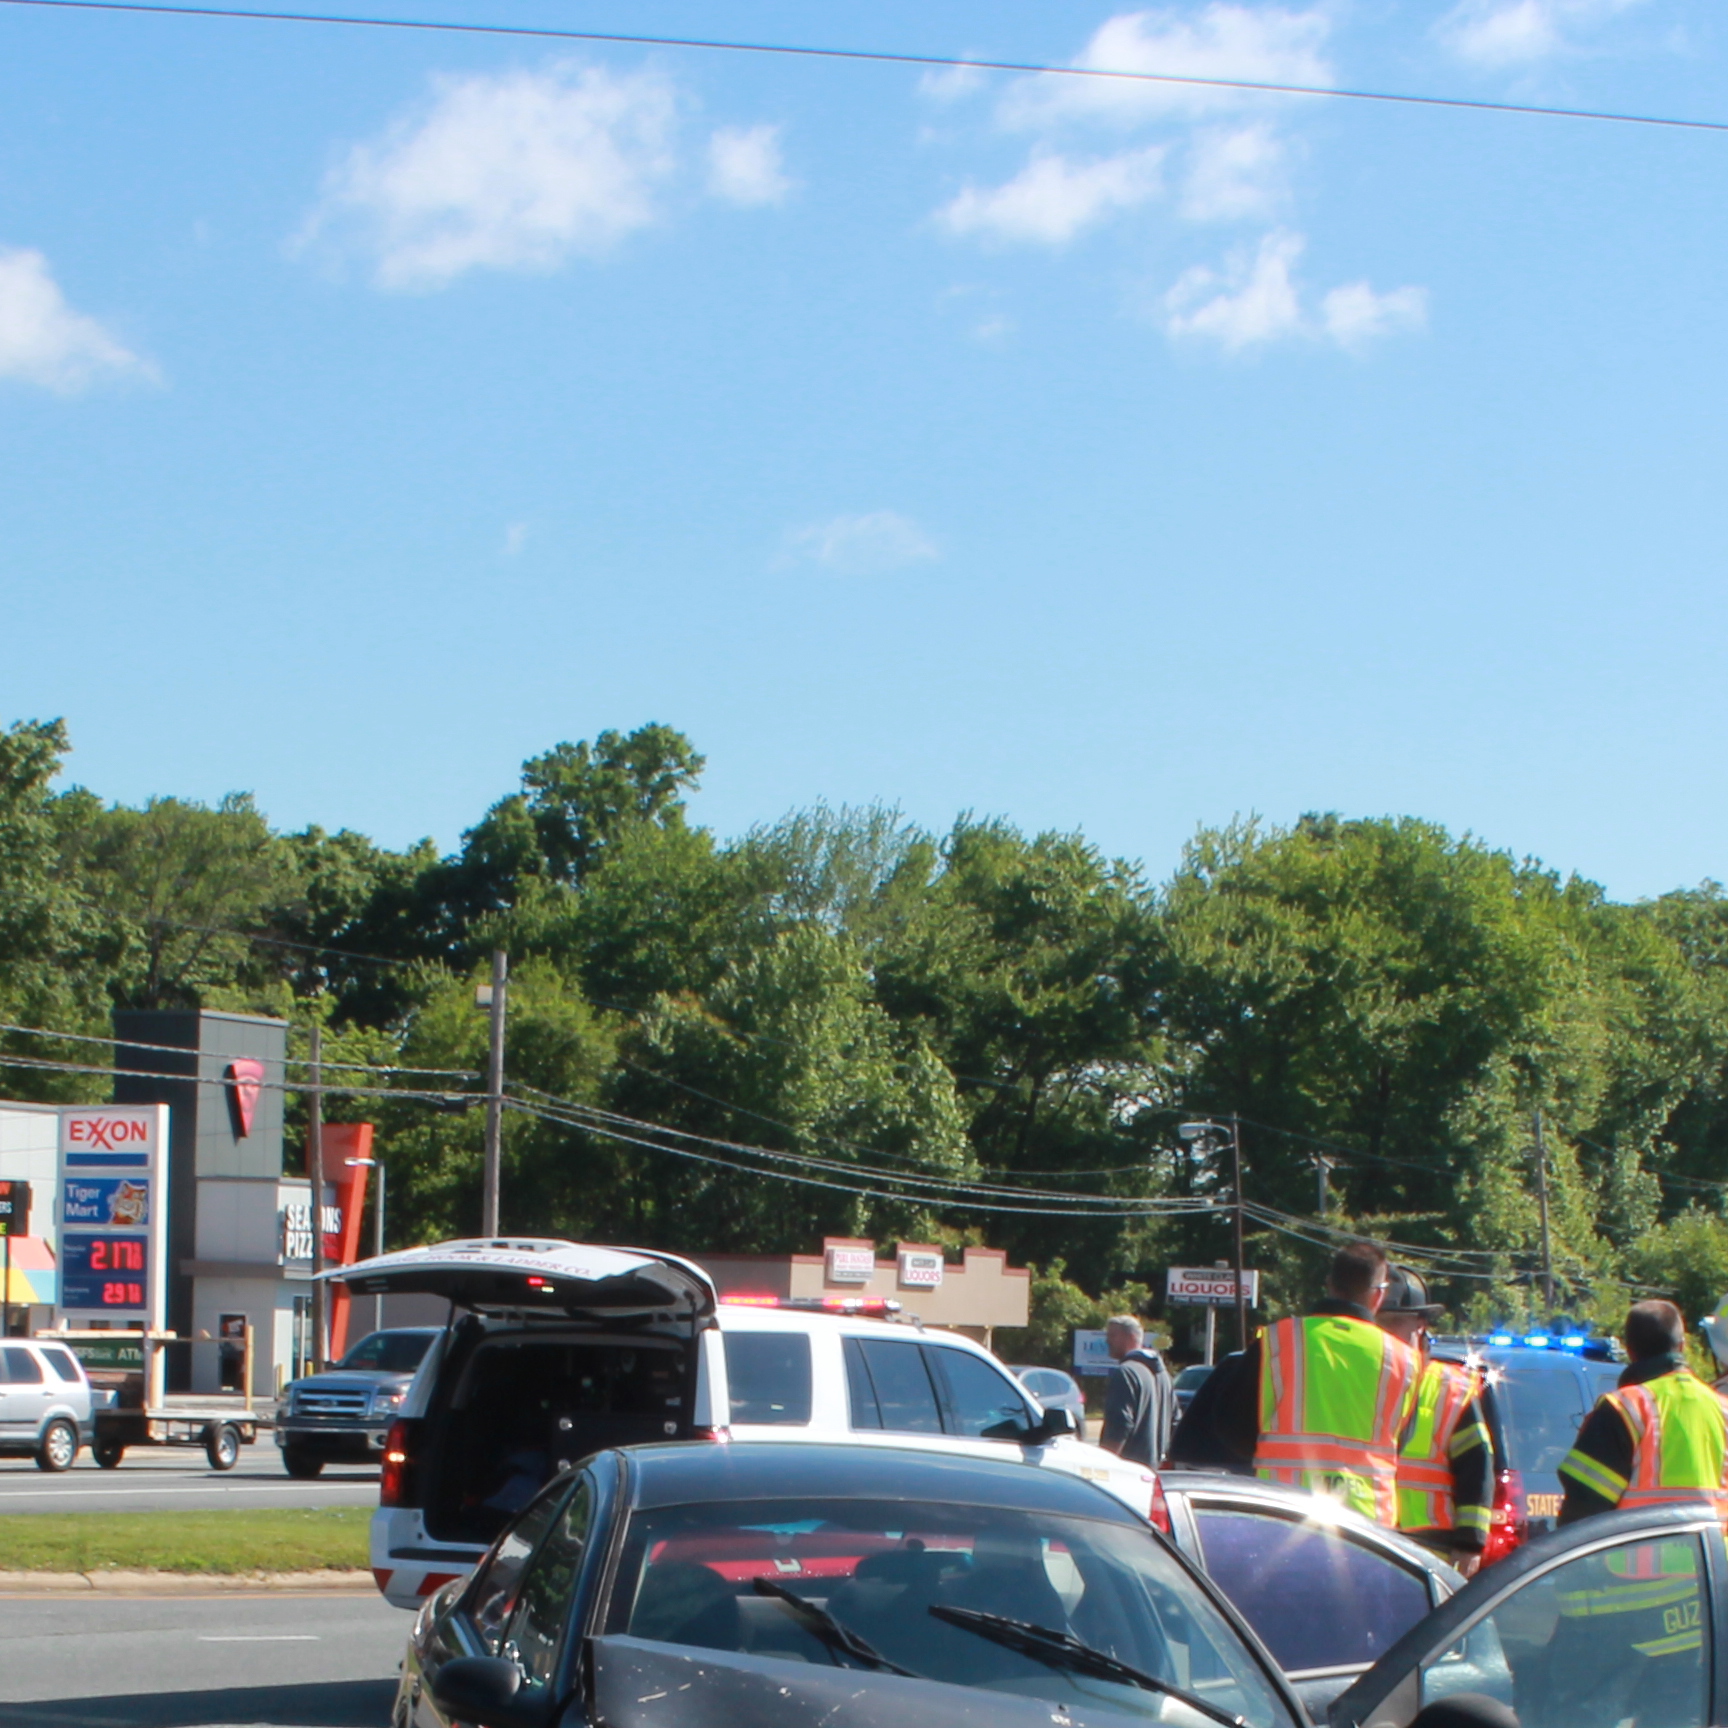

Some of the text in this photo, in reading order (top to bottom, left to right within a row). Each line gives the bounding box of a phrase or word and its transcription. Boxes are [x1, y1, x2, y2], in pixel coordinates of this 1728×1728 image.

[69, 1117, 147, 1150] EXXON
[65, 1184, 101, 1199] Tiger
[65, 1203, 99, 1217] Mart
[286, 1204, 341, 1233] SEAONS
[285, 1231, 315, 1259] PIZZ
[1526, 1494, 1561, 1517] STATE
